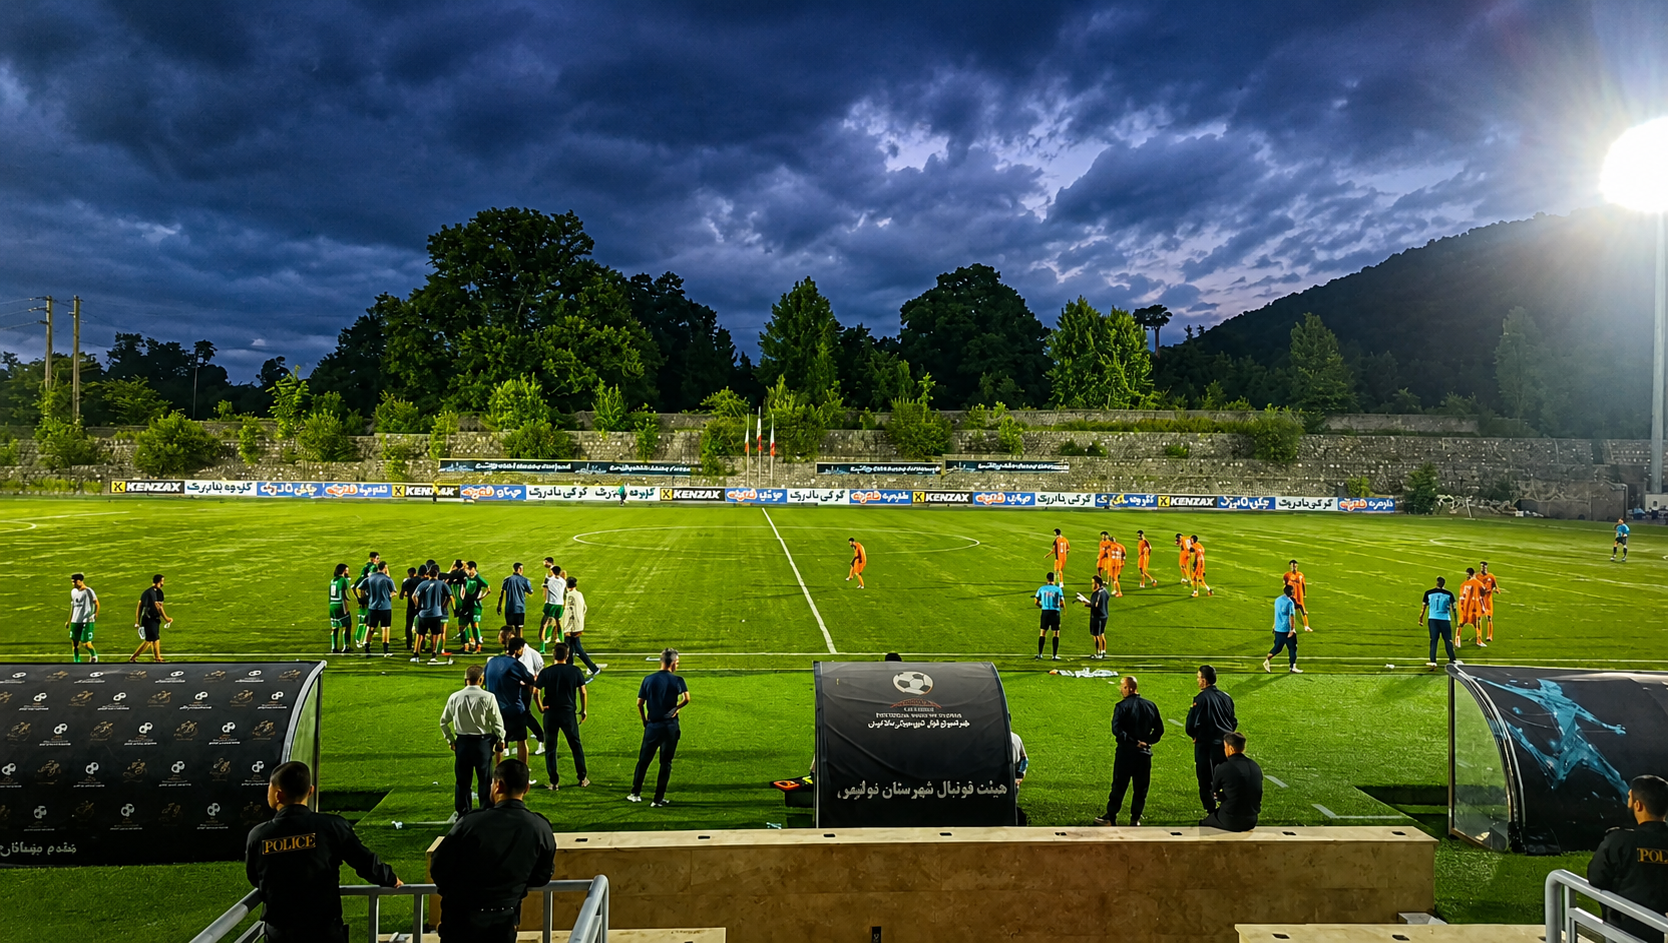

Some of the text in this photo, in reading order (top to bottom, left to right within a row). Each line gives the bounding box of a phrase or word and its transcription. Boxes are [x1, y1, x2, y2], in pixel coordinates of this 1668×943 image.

[126, 482, 182, 492] KENZAX
[673, 489, 721, 499] KENZAX
[926, 493, 970, 502] KENZAX
[264, 834, 316, 853] POLICE
